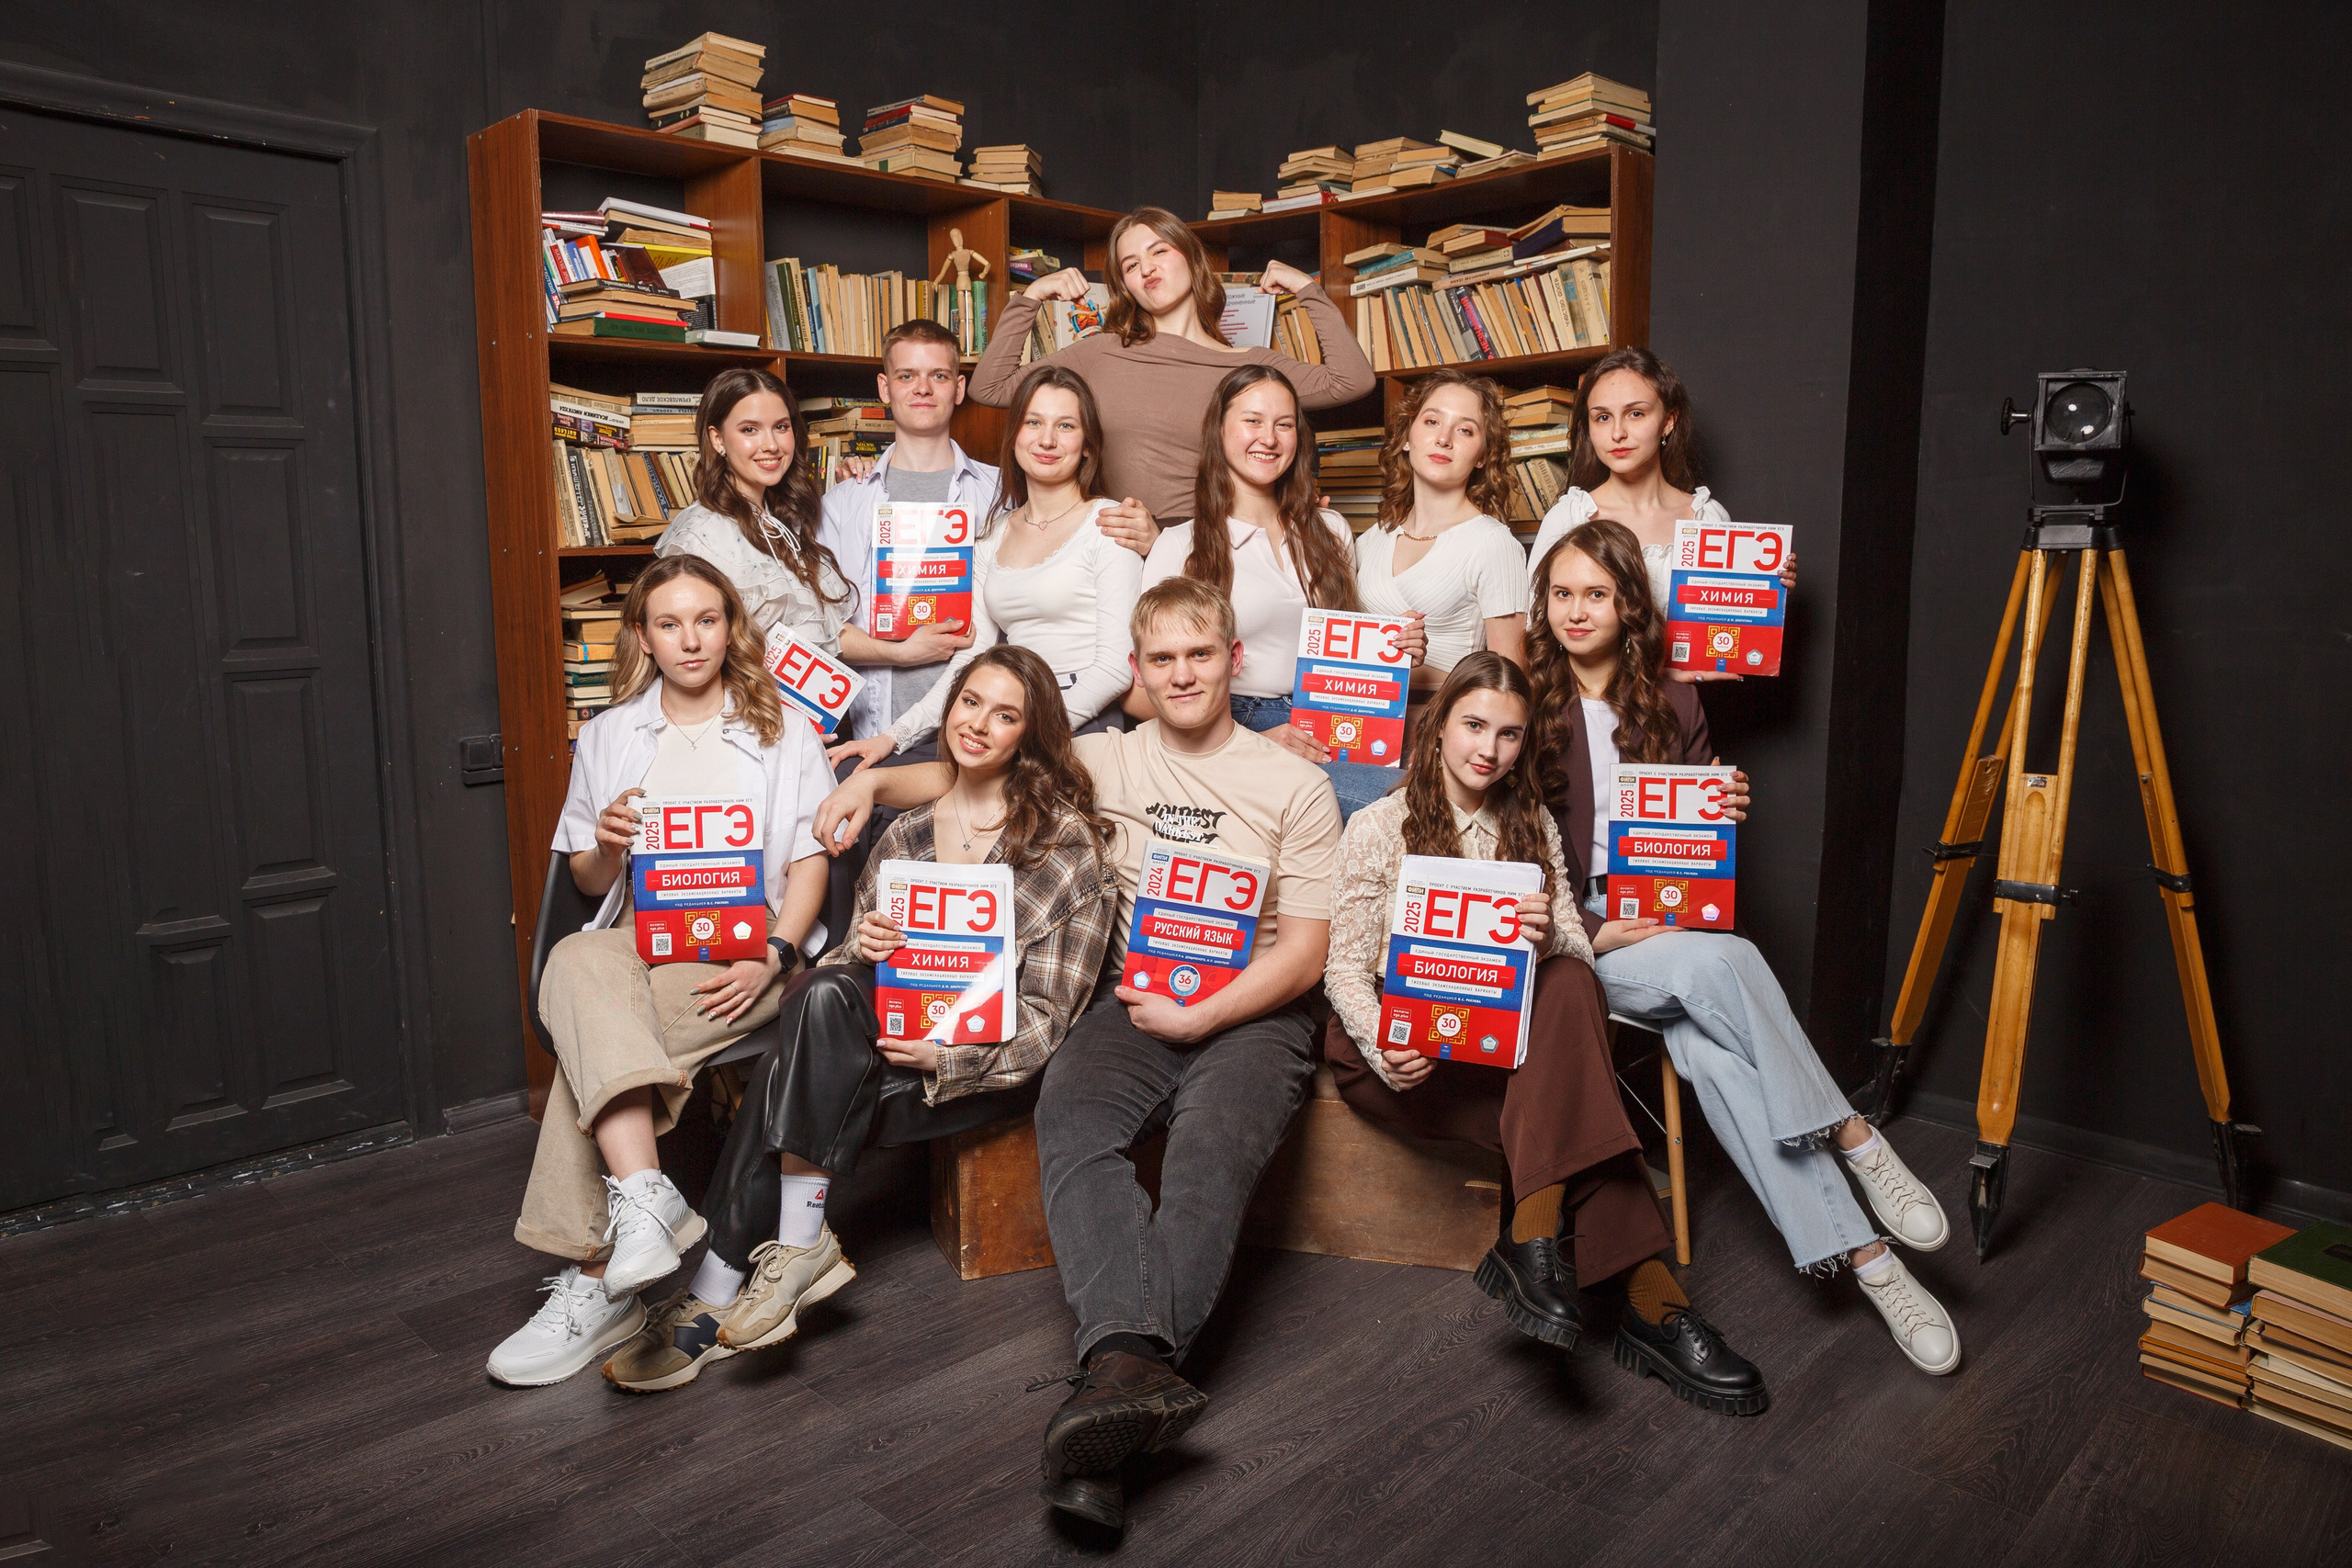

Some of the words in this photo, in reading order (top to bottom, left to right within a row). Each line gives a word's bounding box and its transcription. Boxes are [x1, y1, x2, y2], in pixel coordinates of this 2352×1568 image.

[1461, 295, 1489, 353] НЕЗНАНСКИЙ
[1558, 299, 1569, 328] ЧУВСТВО
[880, 521, 890, 544] 2025
[895, 509, 968, 544] ЕГЭ
[1681, 541, 1695, 567] 2025
[1698, 529, 1782, 571] ЕГЭ
[899, 564, 946, 575] ХИМИЯ
[1700, 591, 1754, 604] ХИМИЯ
[1307, 629, 1320, 656] 2025
[1323, 618, 1405, 663] ЕГЭ
[1717, 637, 1729, 645] 30
[763, 645, 782, 671] 2025
[774, 643, 851, 709] ЕГЭ
[1325, 680, 1377, 695] ХИМИЯ
[1340, 727, 1352, 735] 30
[1621, 790, 1634, 818] 2025
[1639, 777, 1727, 820] ЕГЭ
[646, 821, 660, 850] 2025
[663, 805, 753, 850] ЕГЭ
[1634, 842, 1710, 856] БИОЛОГИЯ
[662, 872, 740, 886] БИОЛОГИЯ
[1147, 867, 1164, 897] 2024
[1166, 857, 1258, 910] ЕГЭ
[1665, 890, 1678, 899] 30
[908, 885, 997, 932] ЕГЭ
[1176, 914, 1214, 924] ГОСУДАРСТВЕННЫЙ
[1404, 902, 1421, 933] 2025
[1423, 889, 1523, 944] ЕГЭ
[696, 922, 709, 931] 30
[1154, 921, 1200, 940] РУССКИЙ
[1204, 930, 1234, 944] ЯЗЫК
[911, 953, 969, 968] ХИМИЯ
[1435, 952, 1479, 961] ГОСУДАРСТВЕННЫЙ
[1179, 975, 1191, 985] 36
[1414, 962, 1498, 983] БИОЛОГИЯ
[932, 1005, 945, 1014] 30
[1442, 1019, 1456, 1029] 30
